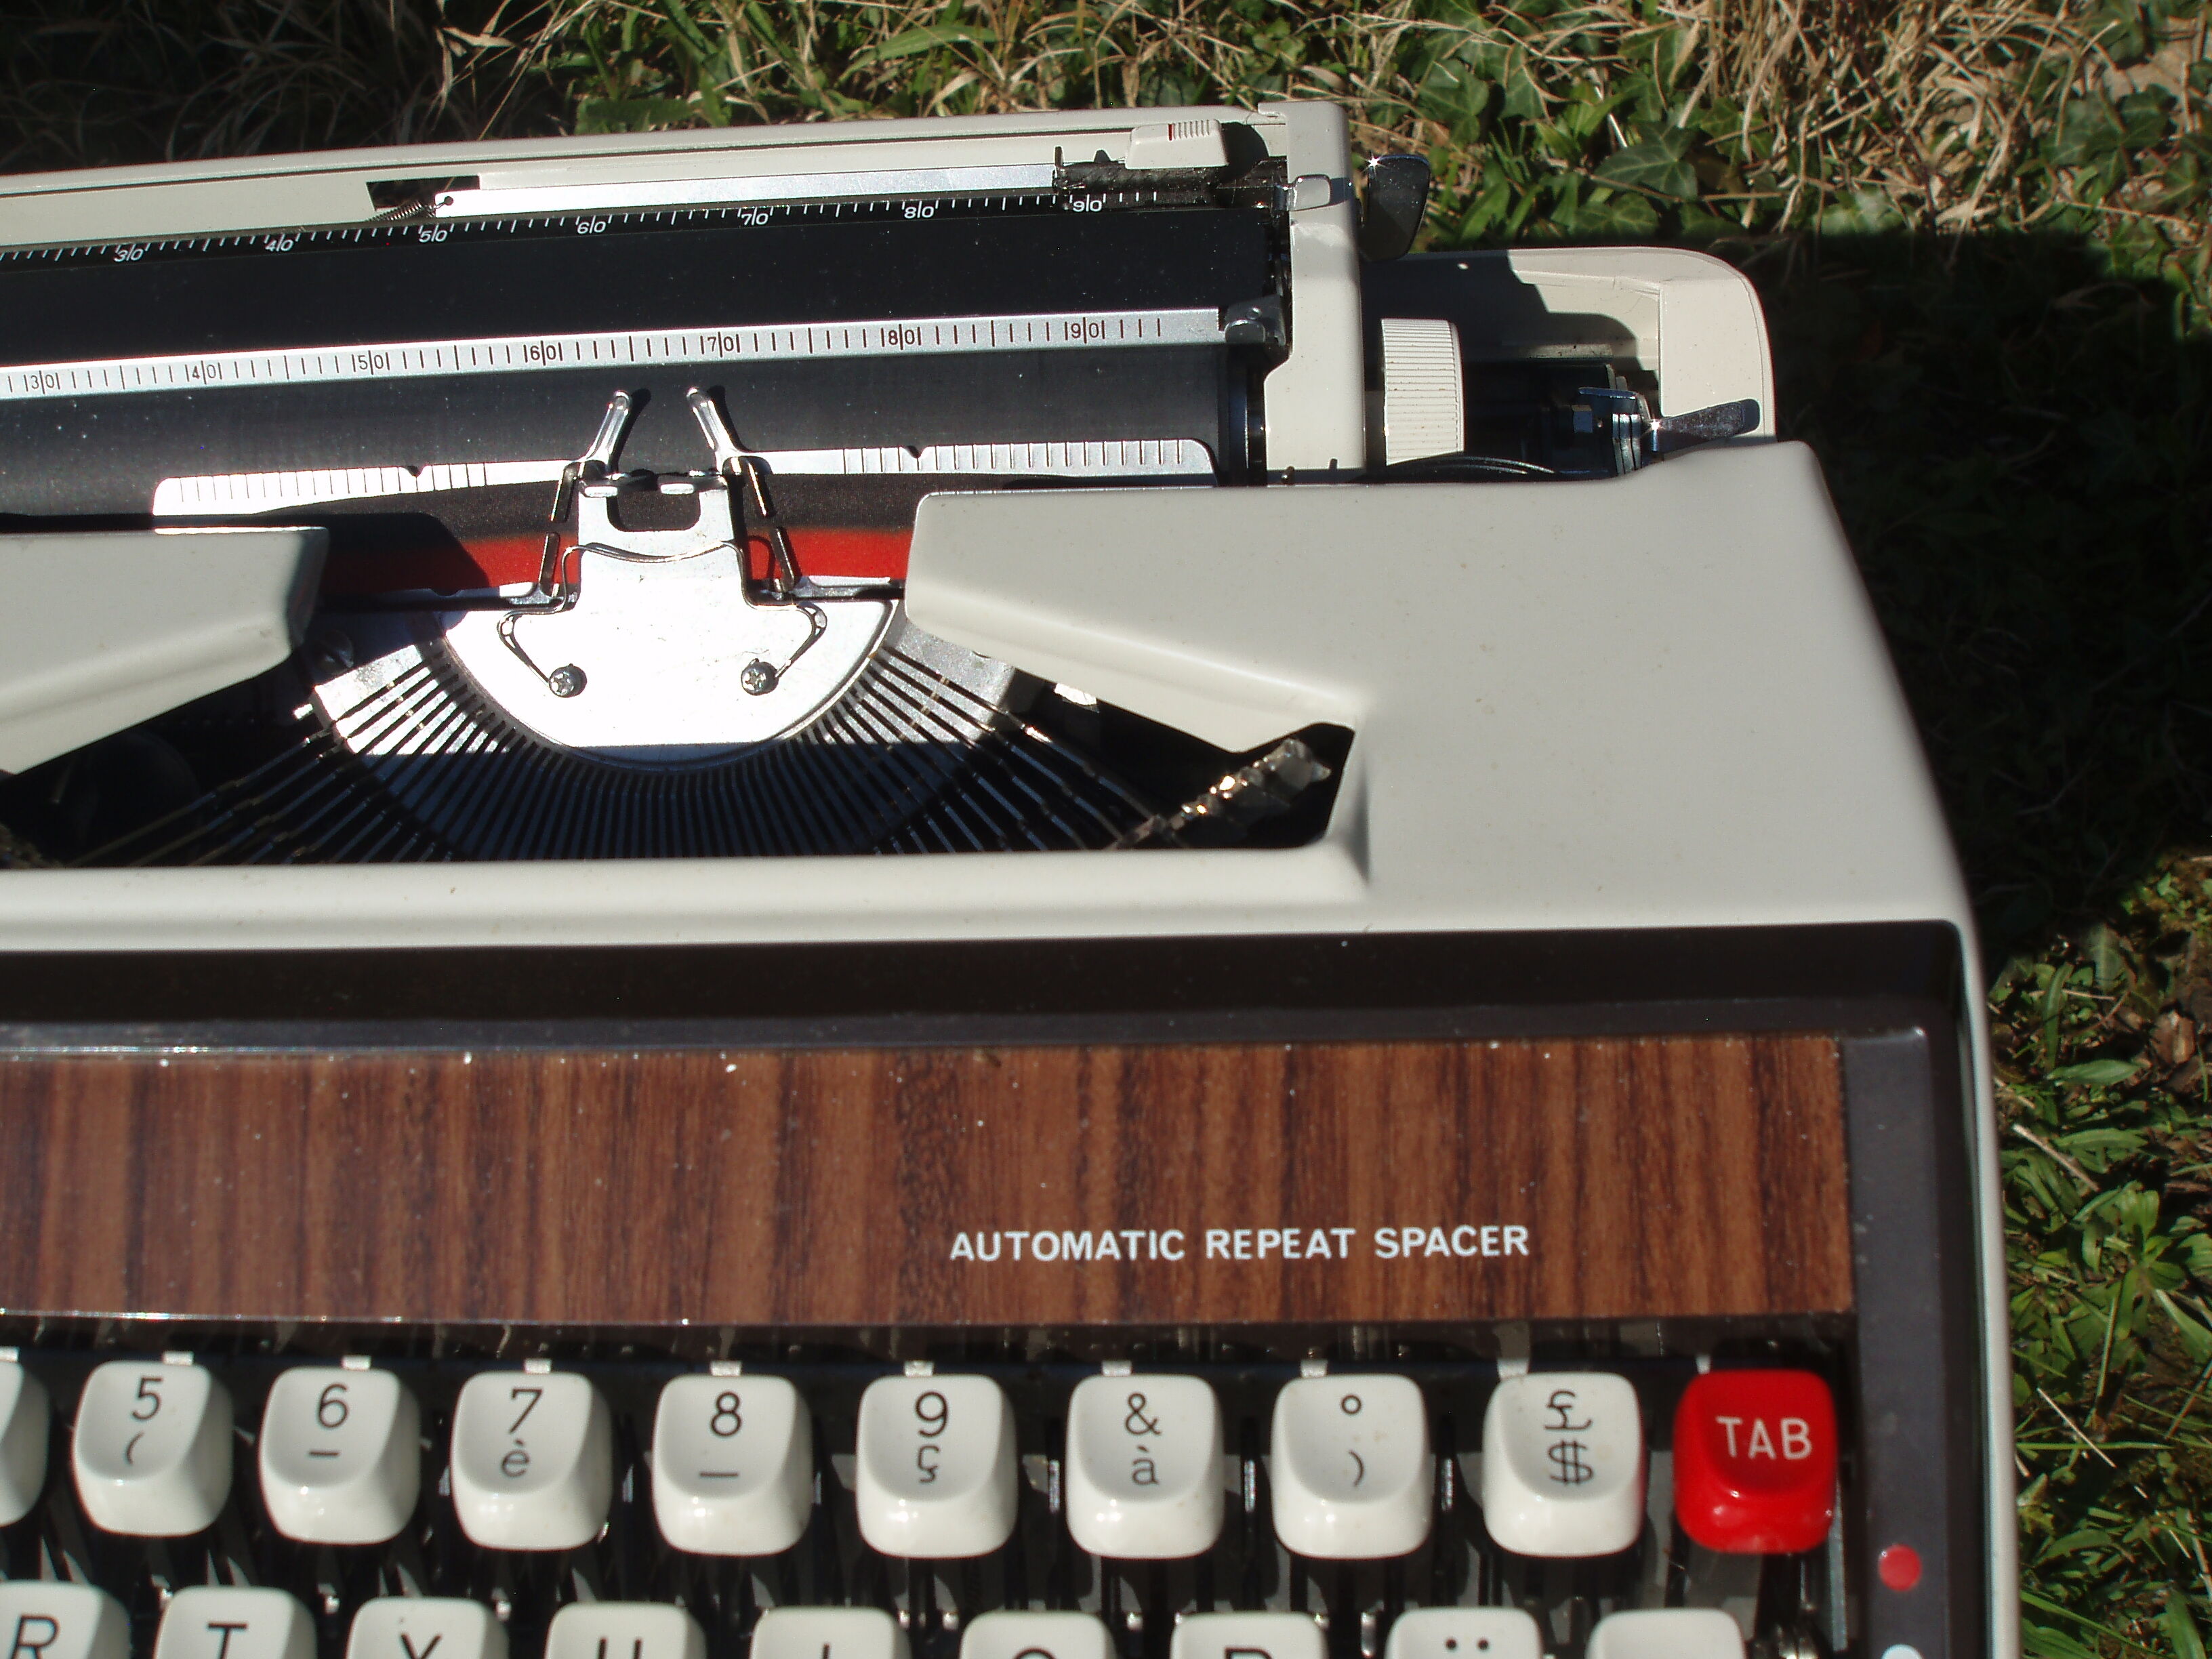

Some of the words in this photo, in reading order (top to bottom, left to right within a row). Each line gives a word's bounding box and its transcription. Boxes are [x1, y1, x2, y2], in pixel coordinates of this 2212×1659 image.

[949, 1228, 1186, 1262] AUTOMATIC
[1205, 1226, 1357, 1261] REPEAT
[1374, 1224, 1531, 1259] SPACER
[131, 1376, 163, 1421] 5
[316, 1383, 349, 1428] 6
[508, 1387, 543, 1435] 7
[710, 1391, 742, 1437] 8
[914, 1391, 949, 1437] 9
[1125, 1392, 1162, 1436] &
[1544, 1389, 1593, 1431] £
[500, 1439, 531, 1478] è
[1715, 1415, 1813, 1460] TAB
[916, 1443, 941, 1483] ç
[1130, 1445, 1161, 1486] à
[1547, 1439, 1595, 1486] $
[10, 1612, 62, 1659] R
[207, 1621, 250, 1659] T
